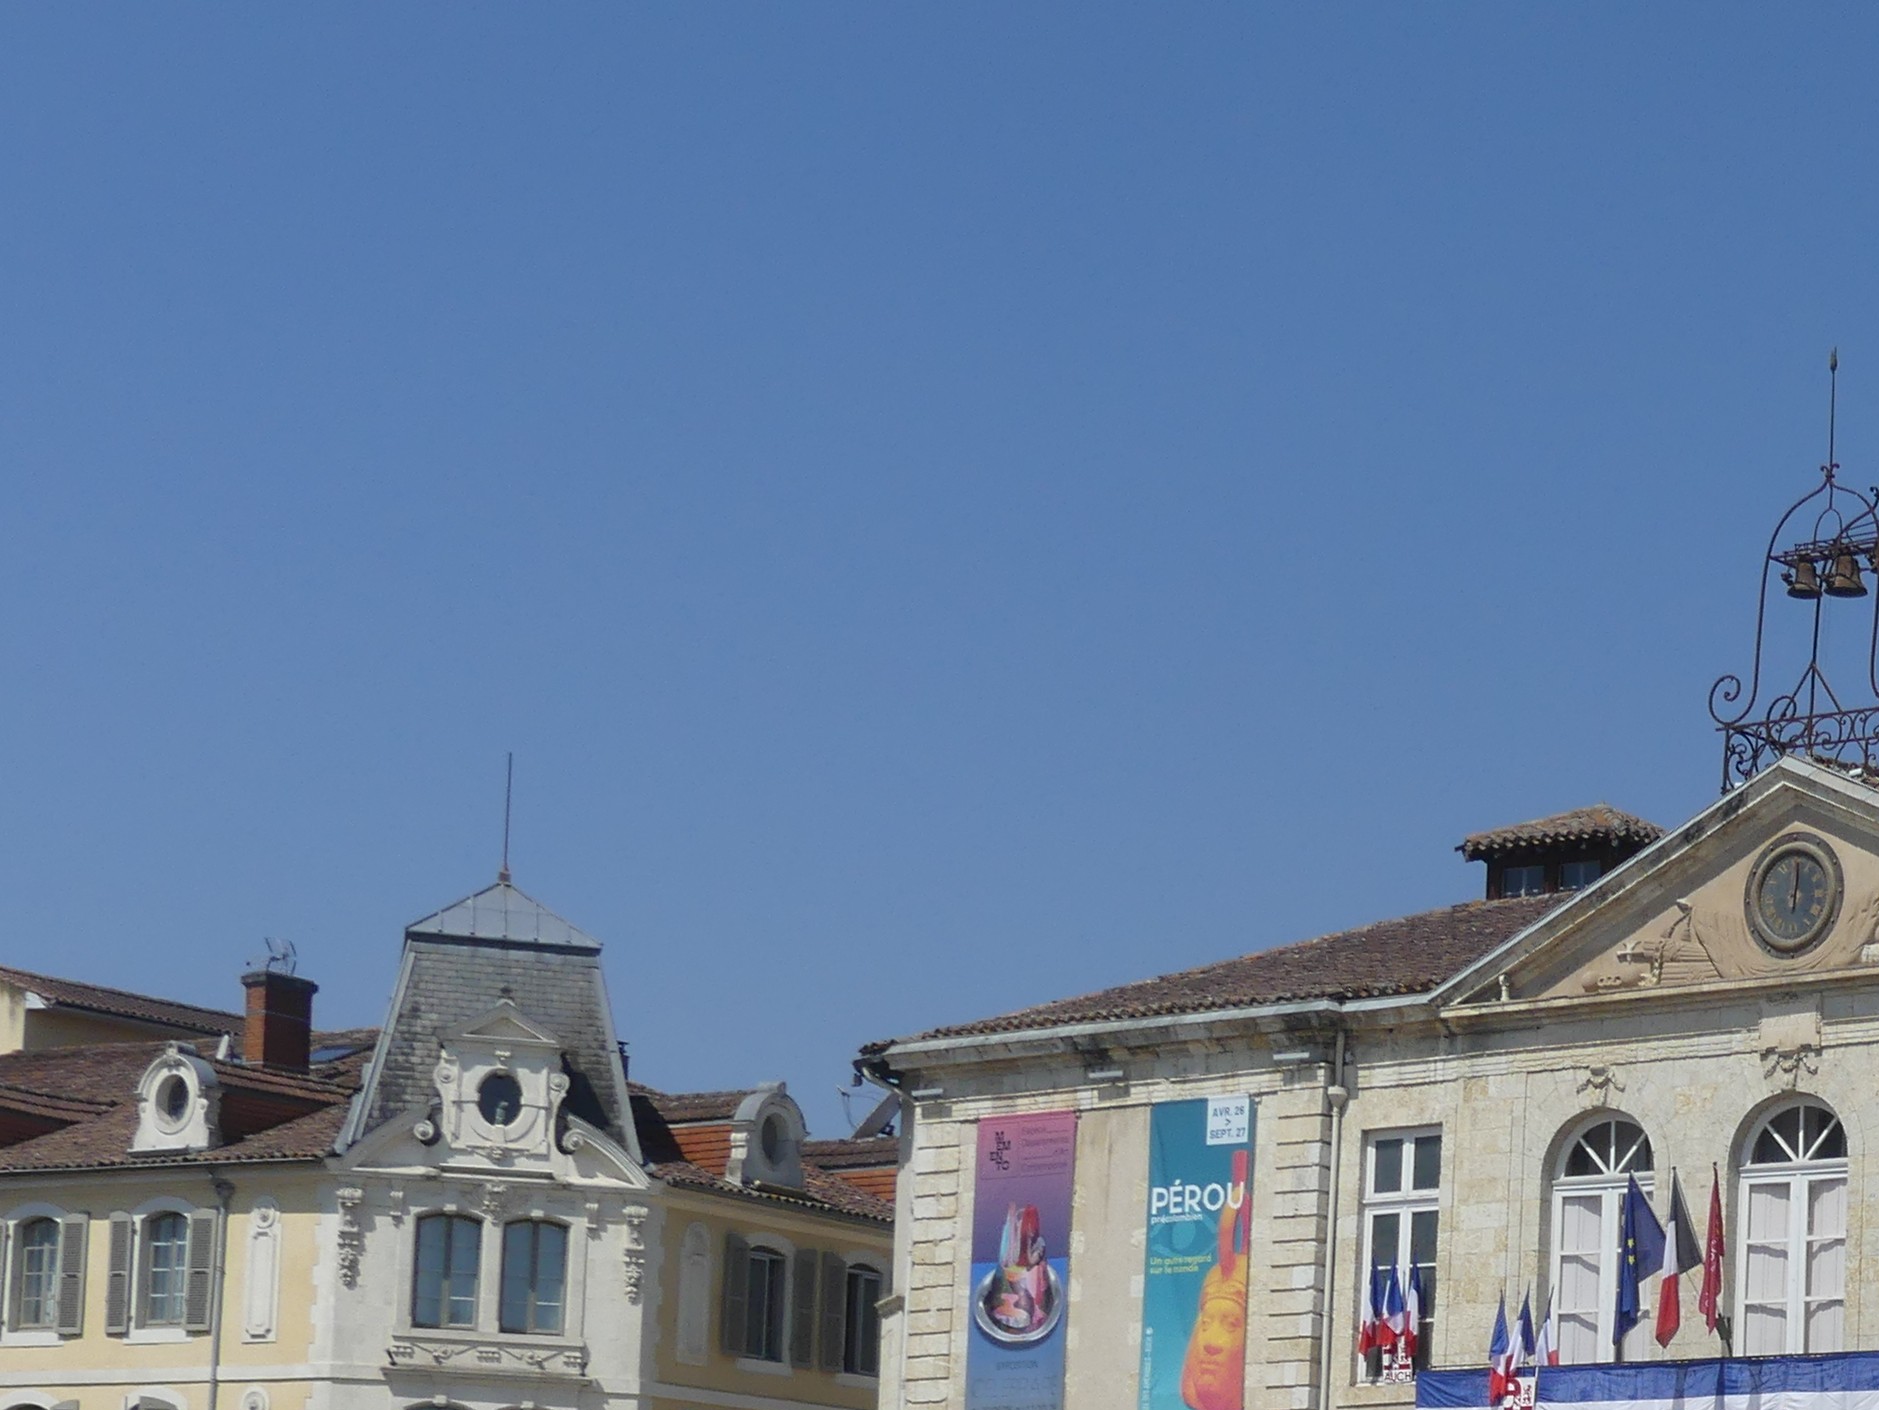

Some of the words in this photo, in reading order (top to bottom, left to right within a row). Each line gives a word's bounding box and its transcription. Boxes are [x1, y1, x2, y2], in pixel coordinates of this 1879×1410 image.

[1209, 1128, 1234, 1140] SEPT.
[1236, 1127, 1246, 1138] 27
[1151, 1179, 1245, 1215] PÉROU
[1183, 1252, 1212, 1266] regard
[1384, 1371, 1411, 1382] AUCH
